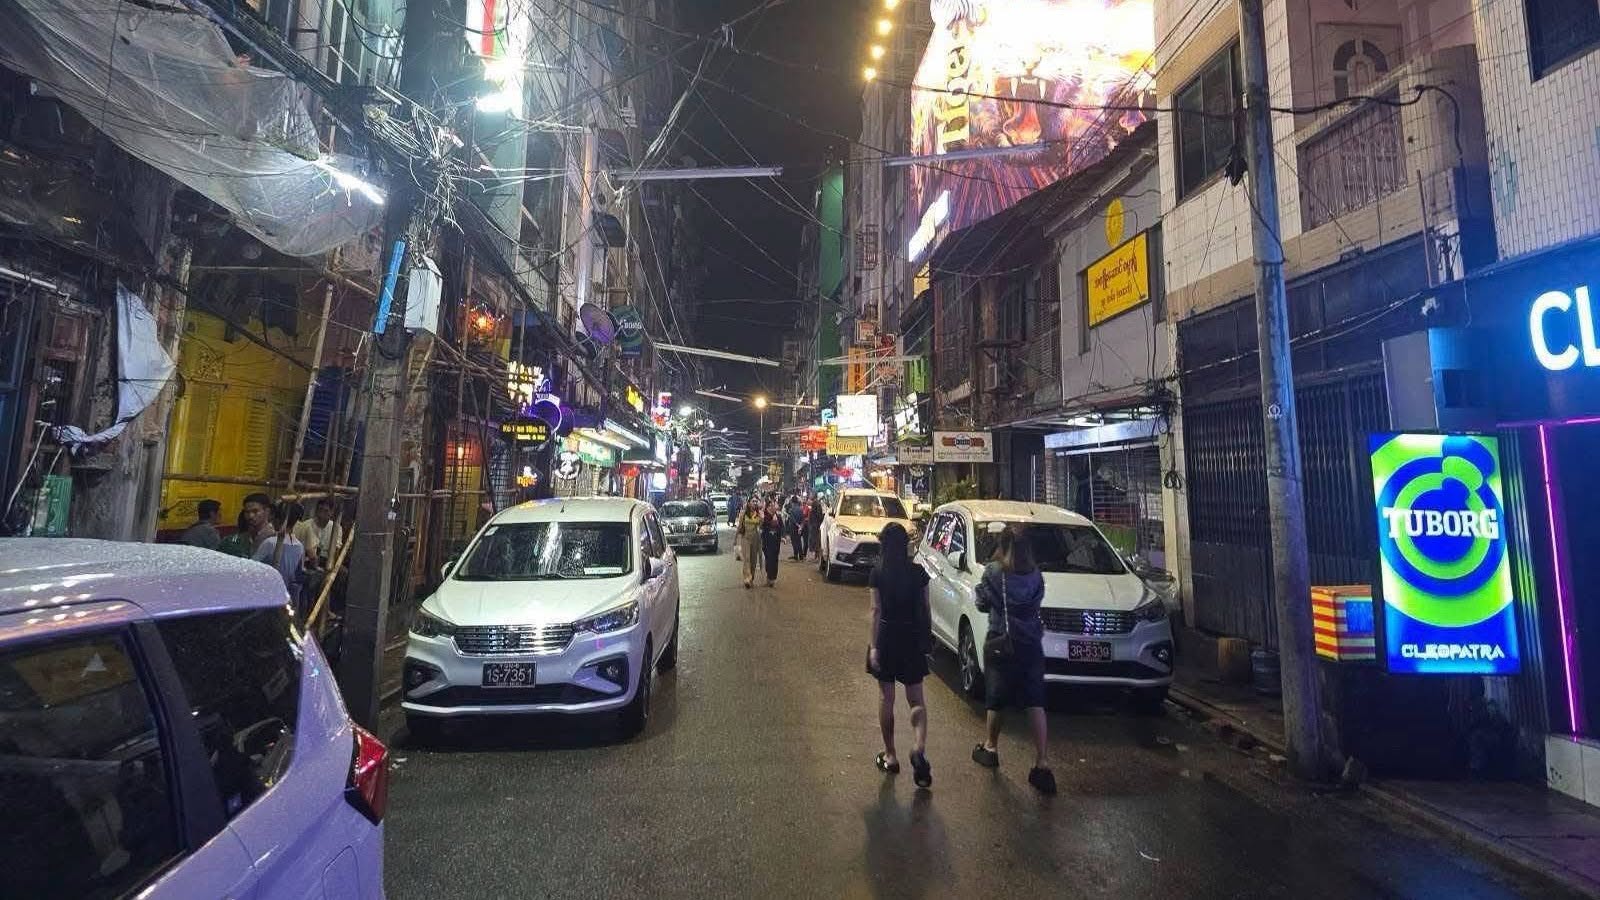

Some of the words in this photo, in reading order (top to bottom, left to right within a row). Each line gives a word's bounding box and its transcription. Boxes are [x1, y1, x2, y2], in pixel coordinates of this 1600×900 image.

[1530, 285, 1600, 371] CL
[1383, 507, 1500, 539] TUBORG
[1401, 644, 1505, 661] CLEOPATRA
[487, 668, 532, 682] 1S-7351
